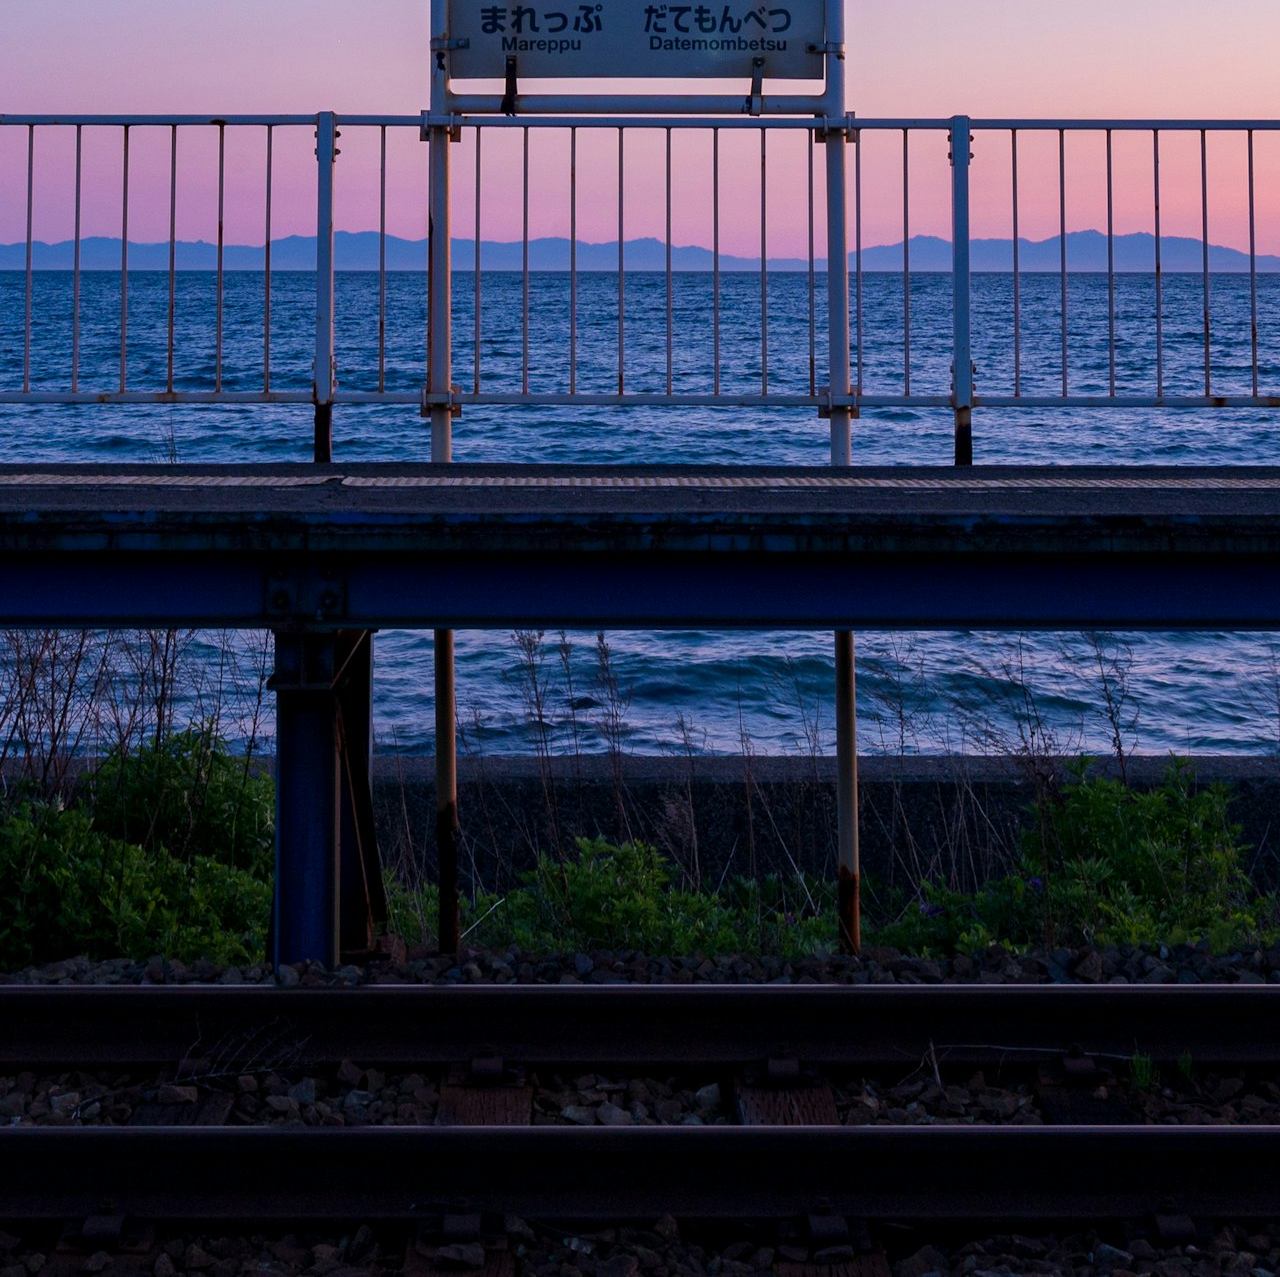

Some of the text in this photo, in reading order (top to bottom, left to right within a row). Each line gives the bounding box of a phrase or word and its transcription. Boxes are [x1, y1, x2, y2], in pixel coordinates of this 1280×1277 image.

[481, 4, 602, 34] まれっぷ
[644, 4, 791, 34] だてもんべつ
[502, 36, 581, 54] Mareppu
[649, 36, 787, 52] Datemombetsu
